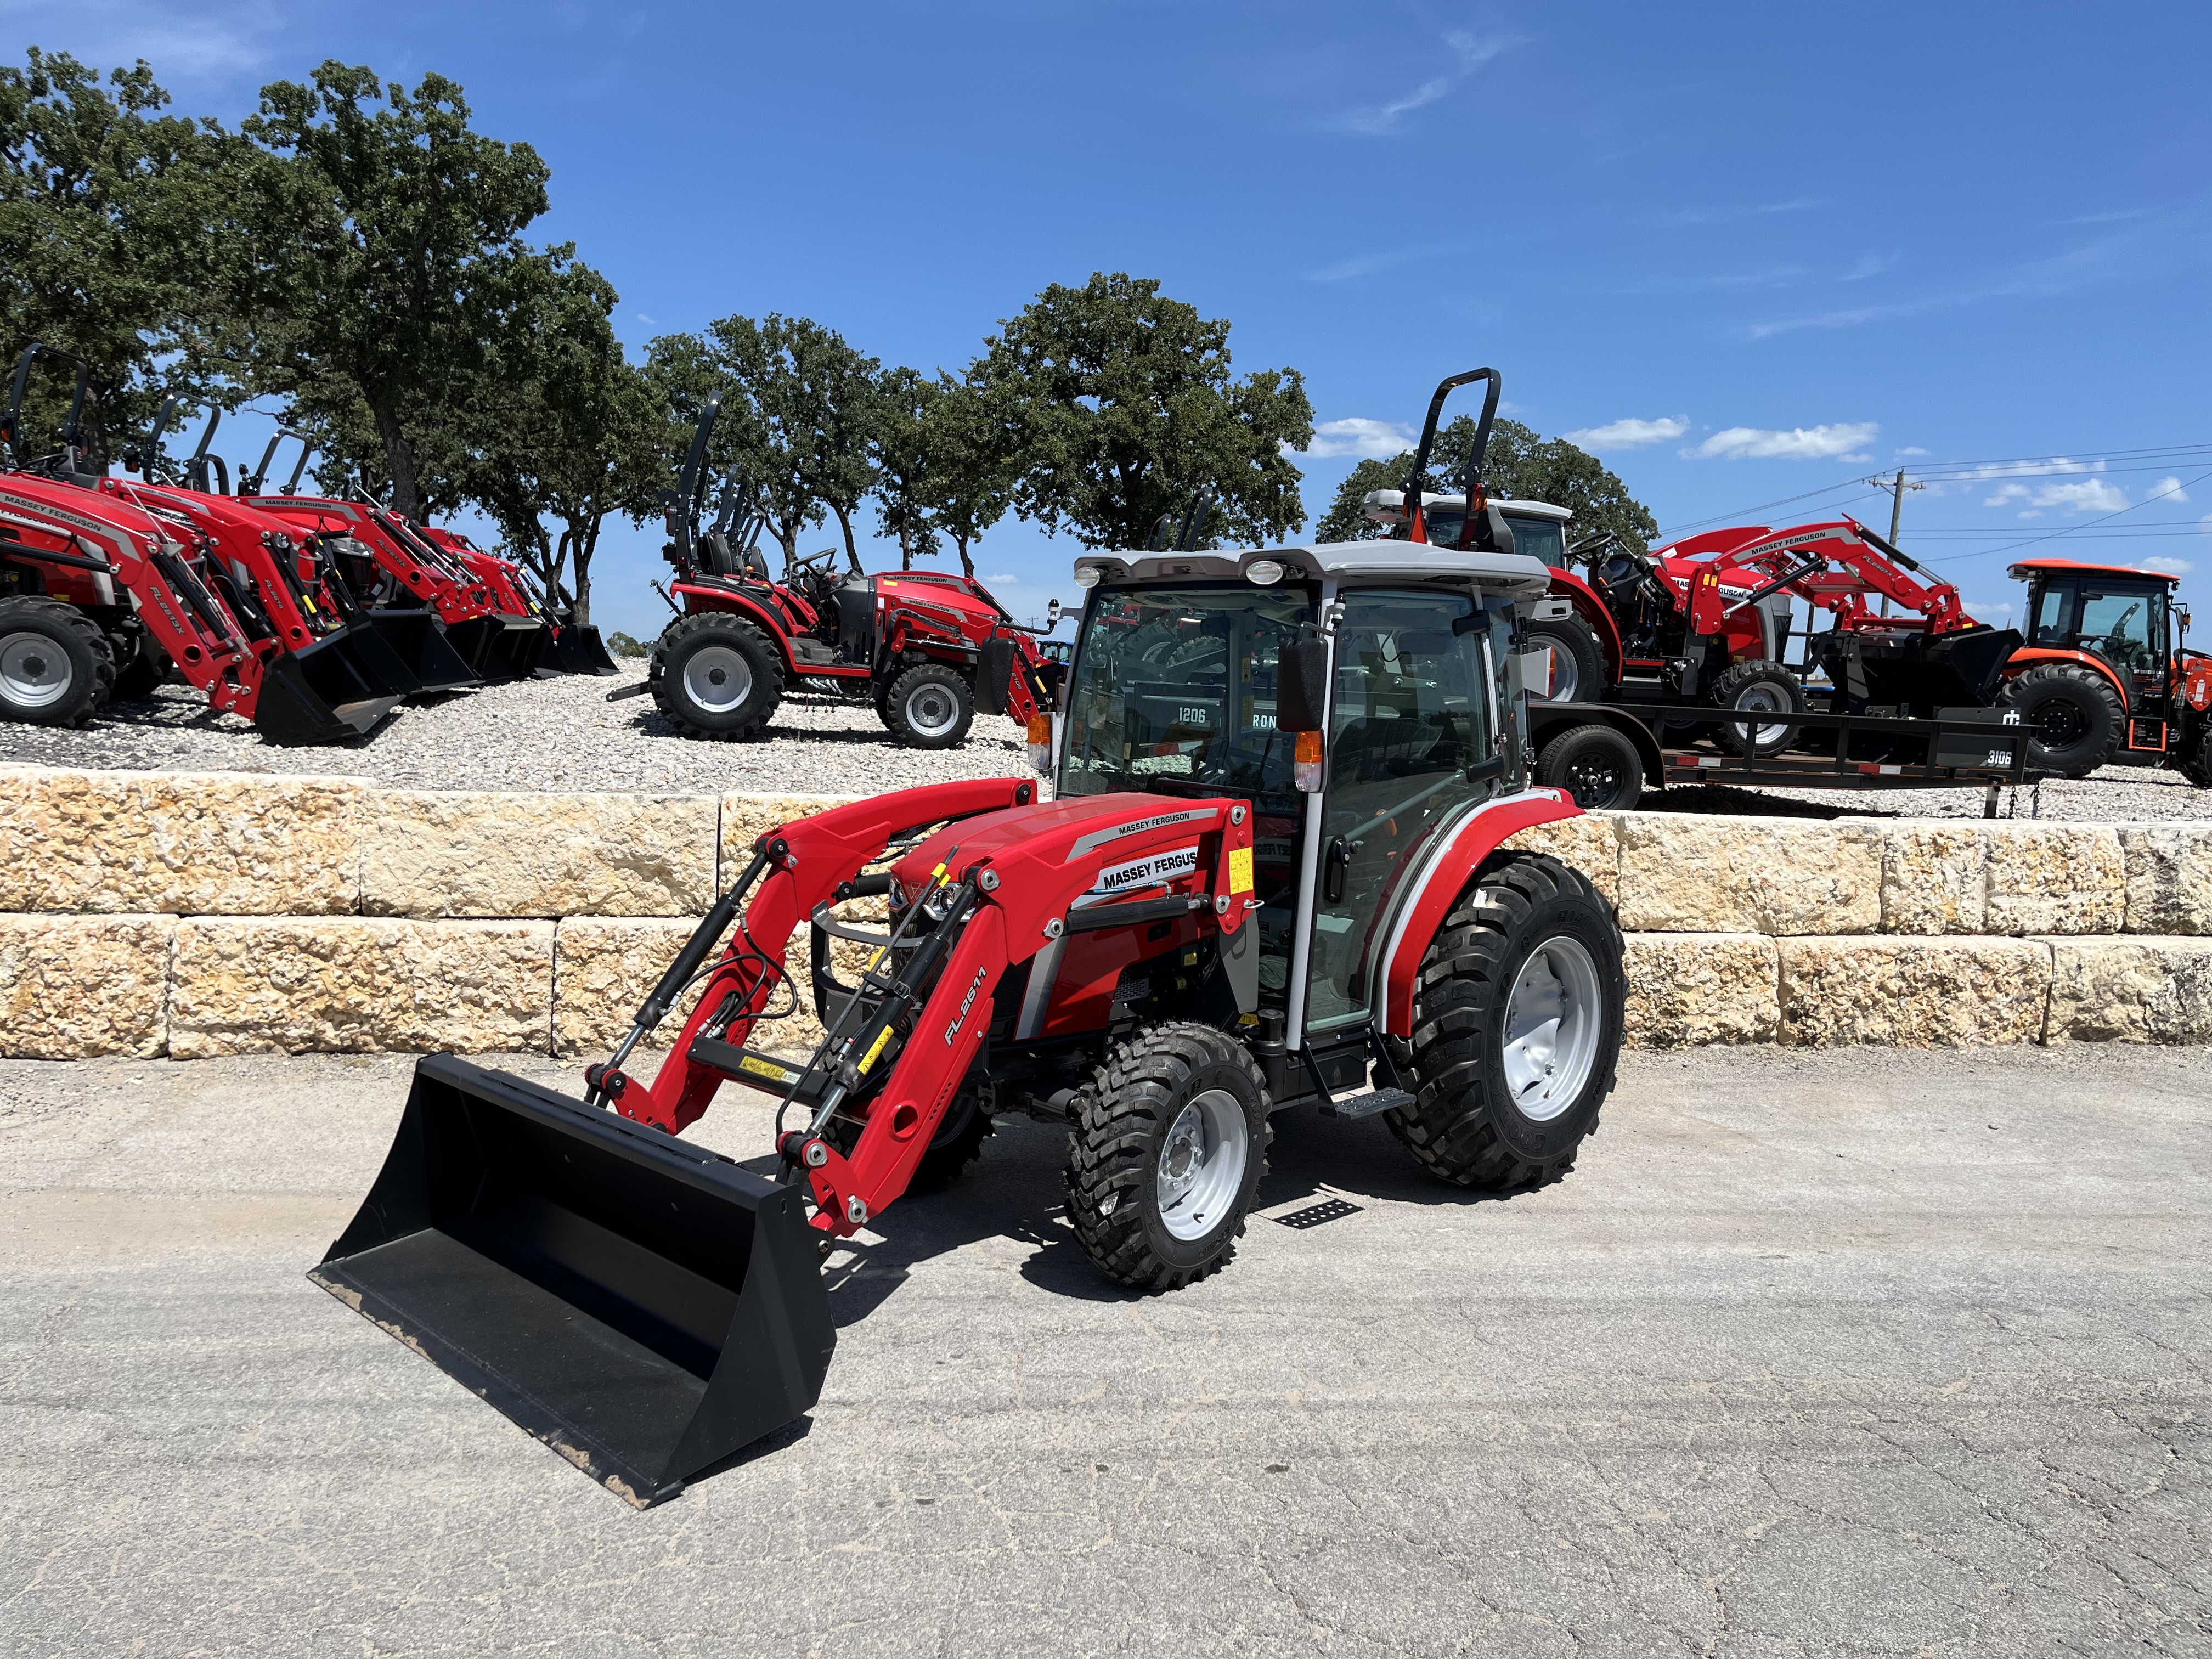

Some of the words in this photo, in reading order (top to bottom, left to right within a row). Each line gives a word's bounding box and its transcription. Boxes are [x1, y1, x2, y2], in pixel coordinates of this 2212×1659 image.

[5, 495, 47, 512] MASSEY
[49, 509, 101, 531] FERGUSON
[1752, 541, 1783, 555] MASSEY
[1785, 532, 1826, 545] FERGUSON
[1719, 587, 1744, 598] GUSON
[927, 603, 950, 612] FERGUSON
[1011, 672, 1023, 690] 2106
[1179, 707, 1206, 723] 1206
[1988, 750, 2012, 765] 3106
[1119, 820, 1149, 834] MASSEY
[1152, 812, 1190, 826] FERGUSON
[1103, 862, 1151, 889] MASSEY
[1154, 851, 1198, 873] FERGUS
[944, 964, 987, 1048] FL.2611
